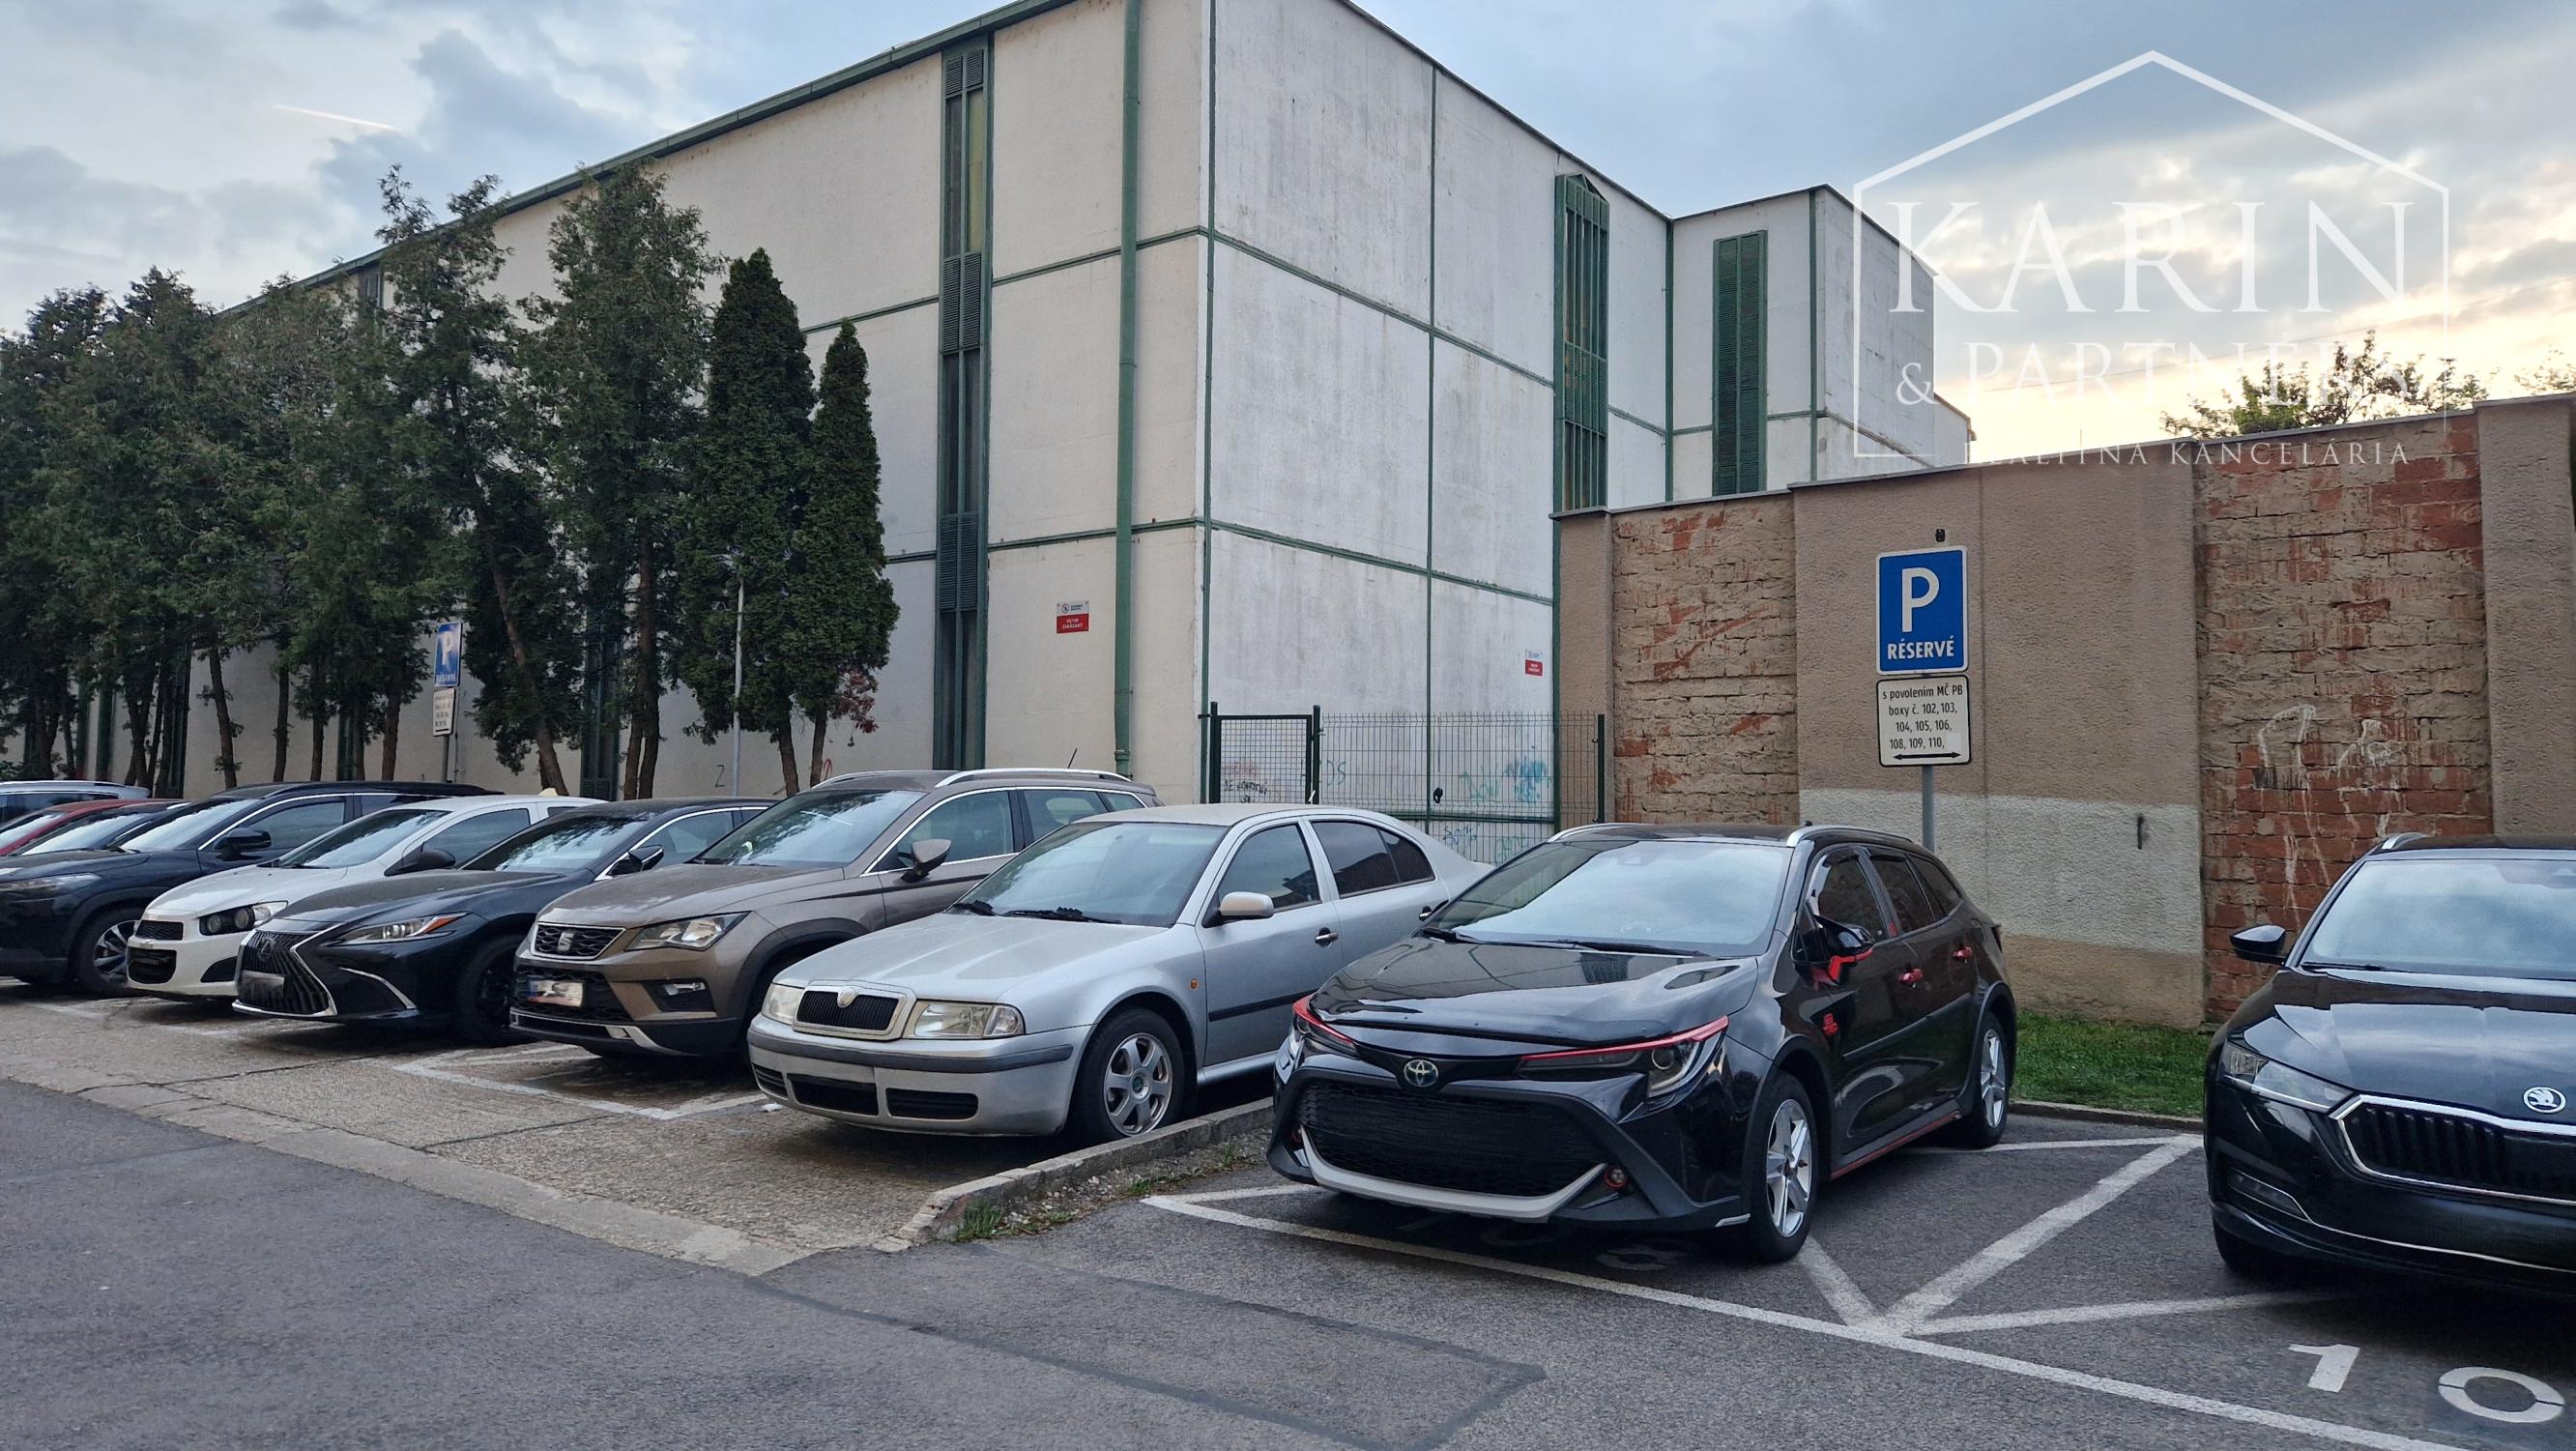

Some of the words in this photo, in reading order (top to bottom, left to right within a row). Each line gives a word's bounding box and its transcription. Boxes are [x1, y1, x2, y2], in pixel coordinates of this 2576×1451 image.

[1901, 566, 1940, 632] P
[1887, 635, 1954, 659] RÉSERVÉ
[1882, 690, 1888, 700] s
[1936, 682, 1950, 696] MČ
[1952, 684, 1963, 696] PB
[1888, 705, 1909, 717] boxy
[1922, 703, 1939, 715] 102,
[1941, 702, 1957, 714] 103,
[1896, 721, 1913, 734] 104,
[1915, 720, 1932, 732] 105,
[1934, 719, 1952, 732] 106,
[1890, 738, 1906, 750] 108,
[1909, 737, 1925, 749] 109,
[1928, 737, 1945, 749] 110,
